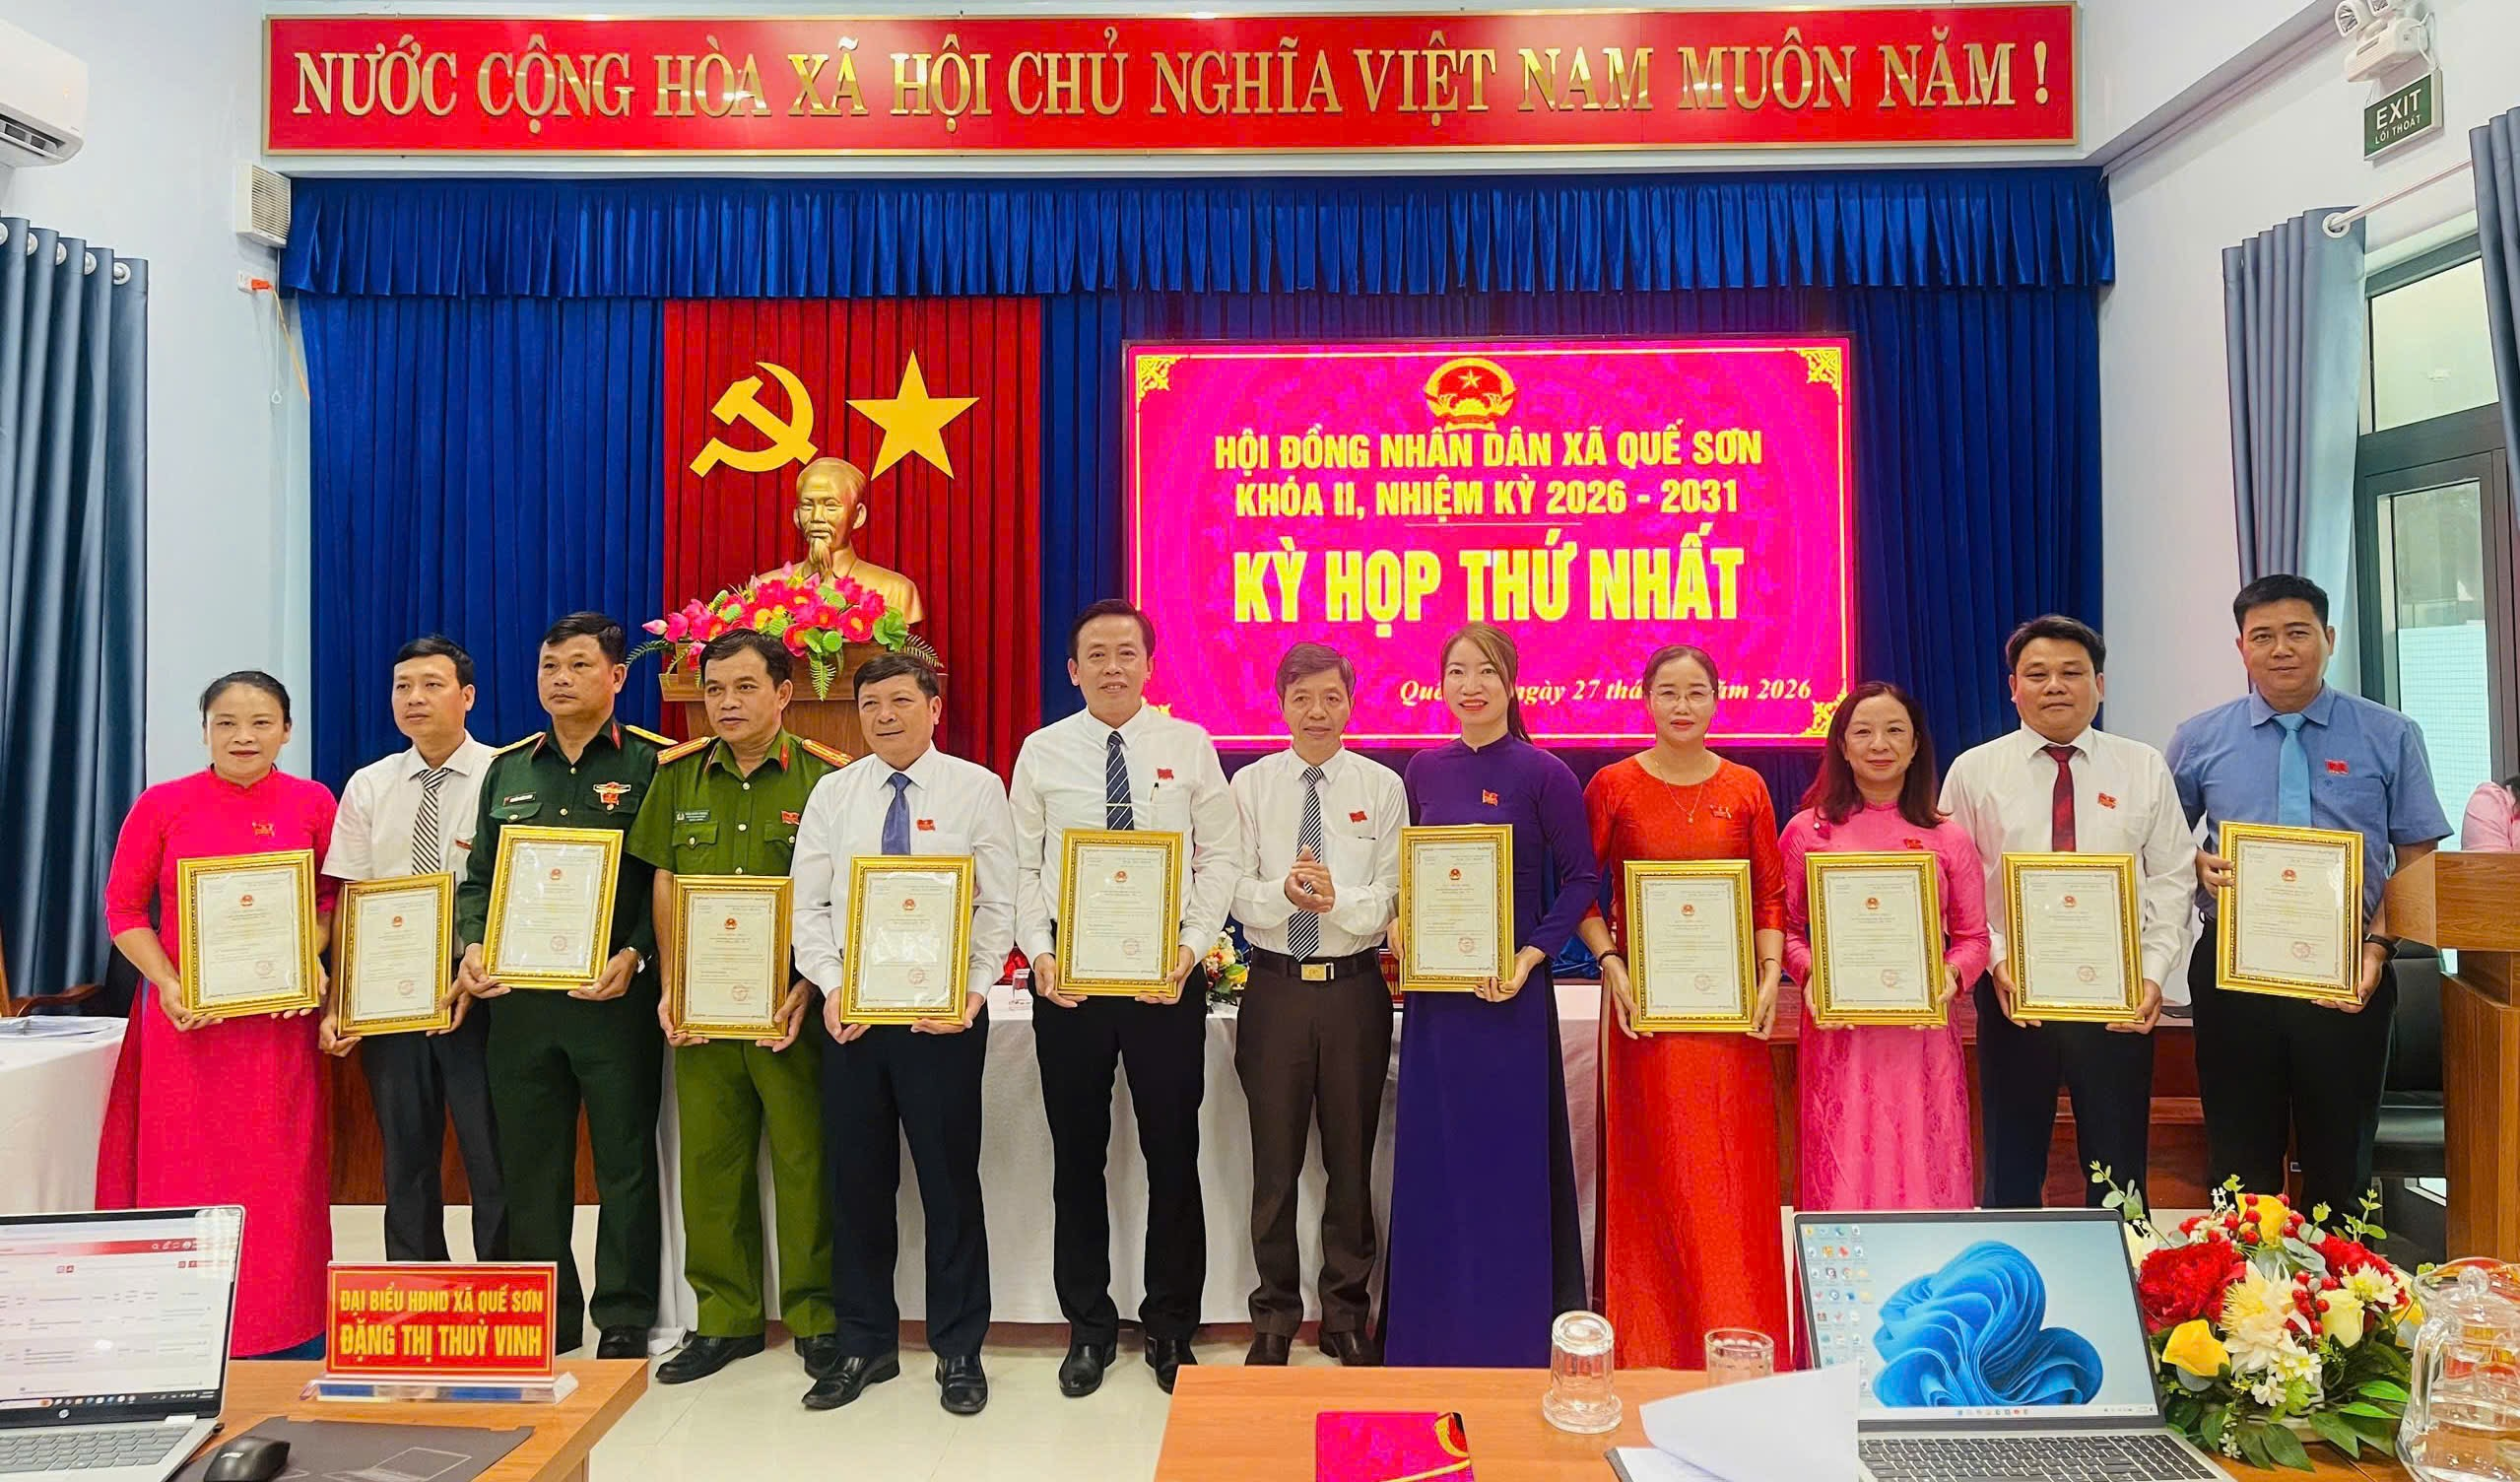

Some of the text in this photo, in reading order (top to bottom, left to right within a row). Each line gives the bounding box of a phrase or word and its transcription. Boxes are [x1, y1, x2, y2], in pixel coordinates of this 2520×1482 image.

[293, 27, 2050, 134] NƯỚC CỘNG HÒA XÃ HỘI CHỦ NGHĨA VIỆT NAM MUÔN NĂM !
[2376, 90, 2421, 130] EXIT
[2393, 114, 2421, 136] THOÁT
[1216, 418, 1761, 469] HỘI ĐỒNG NHÂN DÂN XÃ QUẾ SƠN
[1236, 477, 1323, 516] KHÓA
[1334, 482, 1364, 519] II,
[1376, 474, 1484, 523] NHIỆM
[1493, 473, 1535, 516] KỲ
[1547, 479, 1626, 512] 2026
[1661, 479, 1737, 511] 2031
[1233, 520, 1745, 638] KỲ HỌP THỨ NHẤT
[1571, 680, 1601, 701] 27
[1717, 679, 1750, 700] ăm
[1757, 678, 1812, 700] 2026
[340, 1282, 543, 1315] ĐẠI BIỂU HĐND XÃ QUẾ SƠN
[340, 1318, 543, 1363] ĐẶNG THỊ THUỶ VINH
